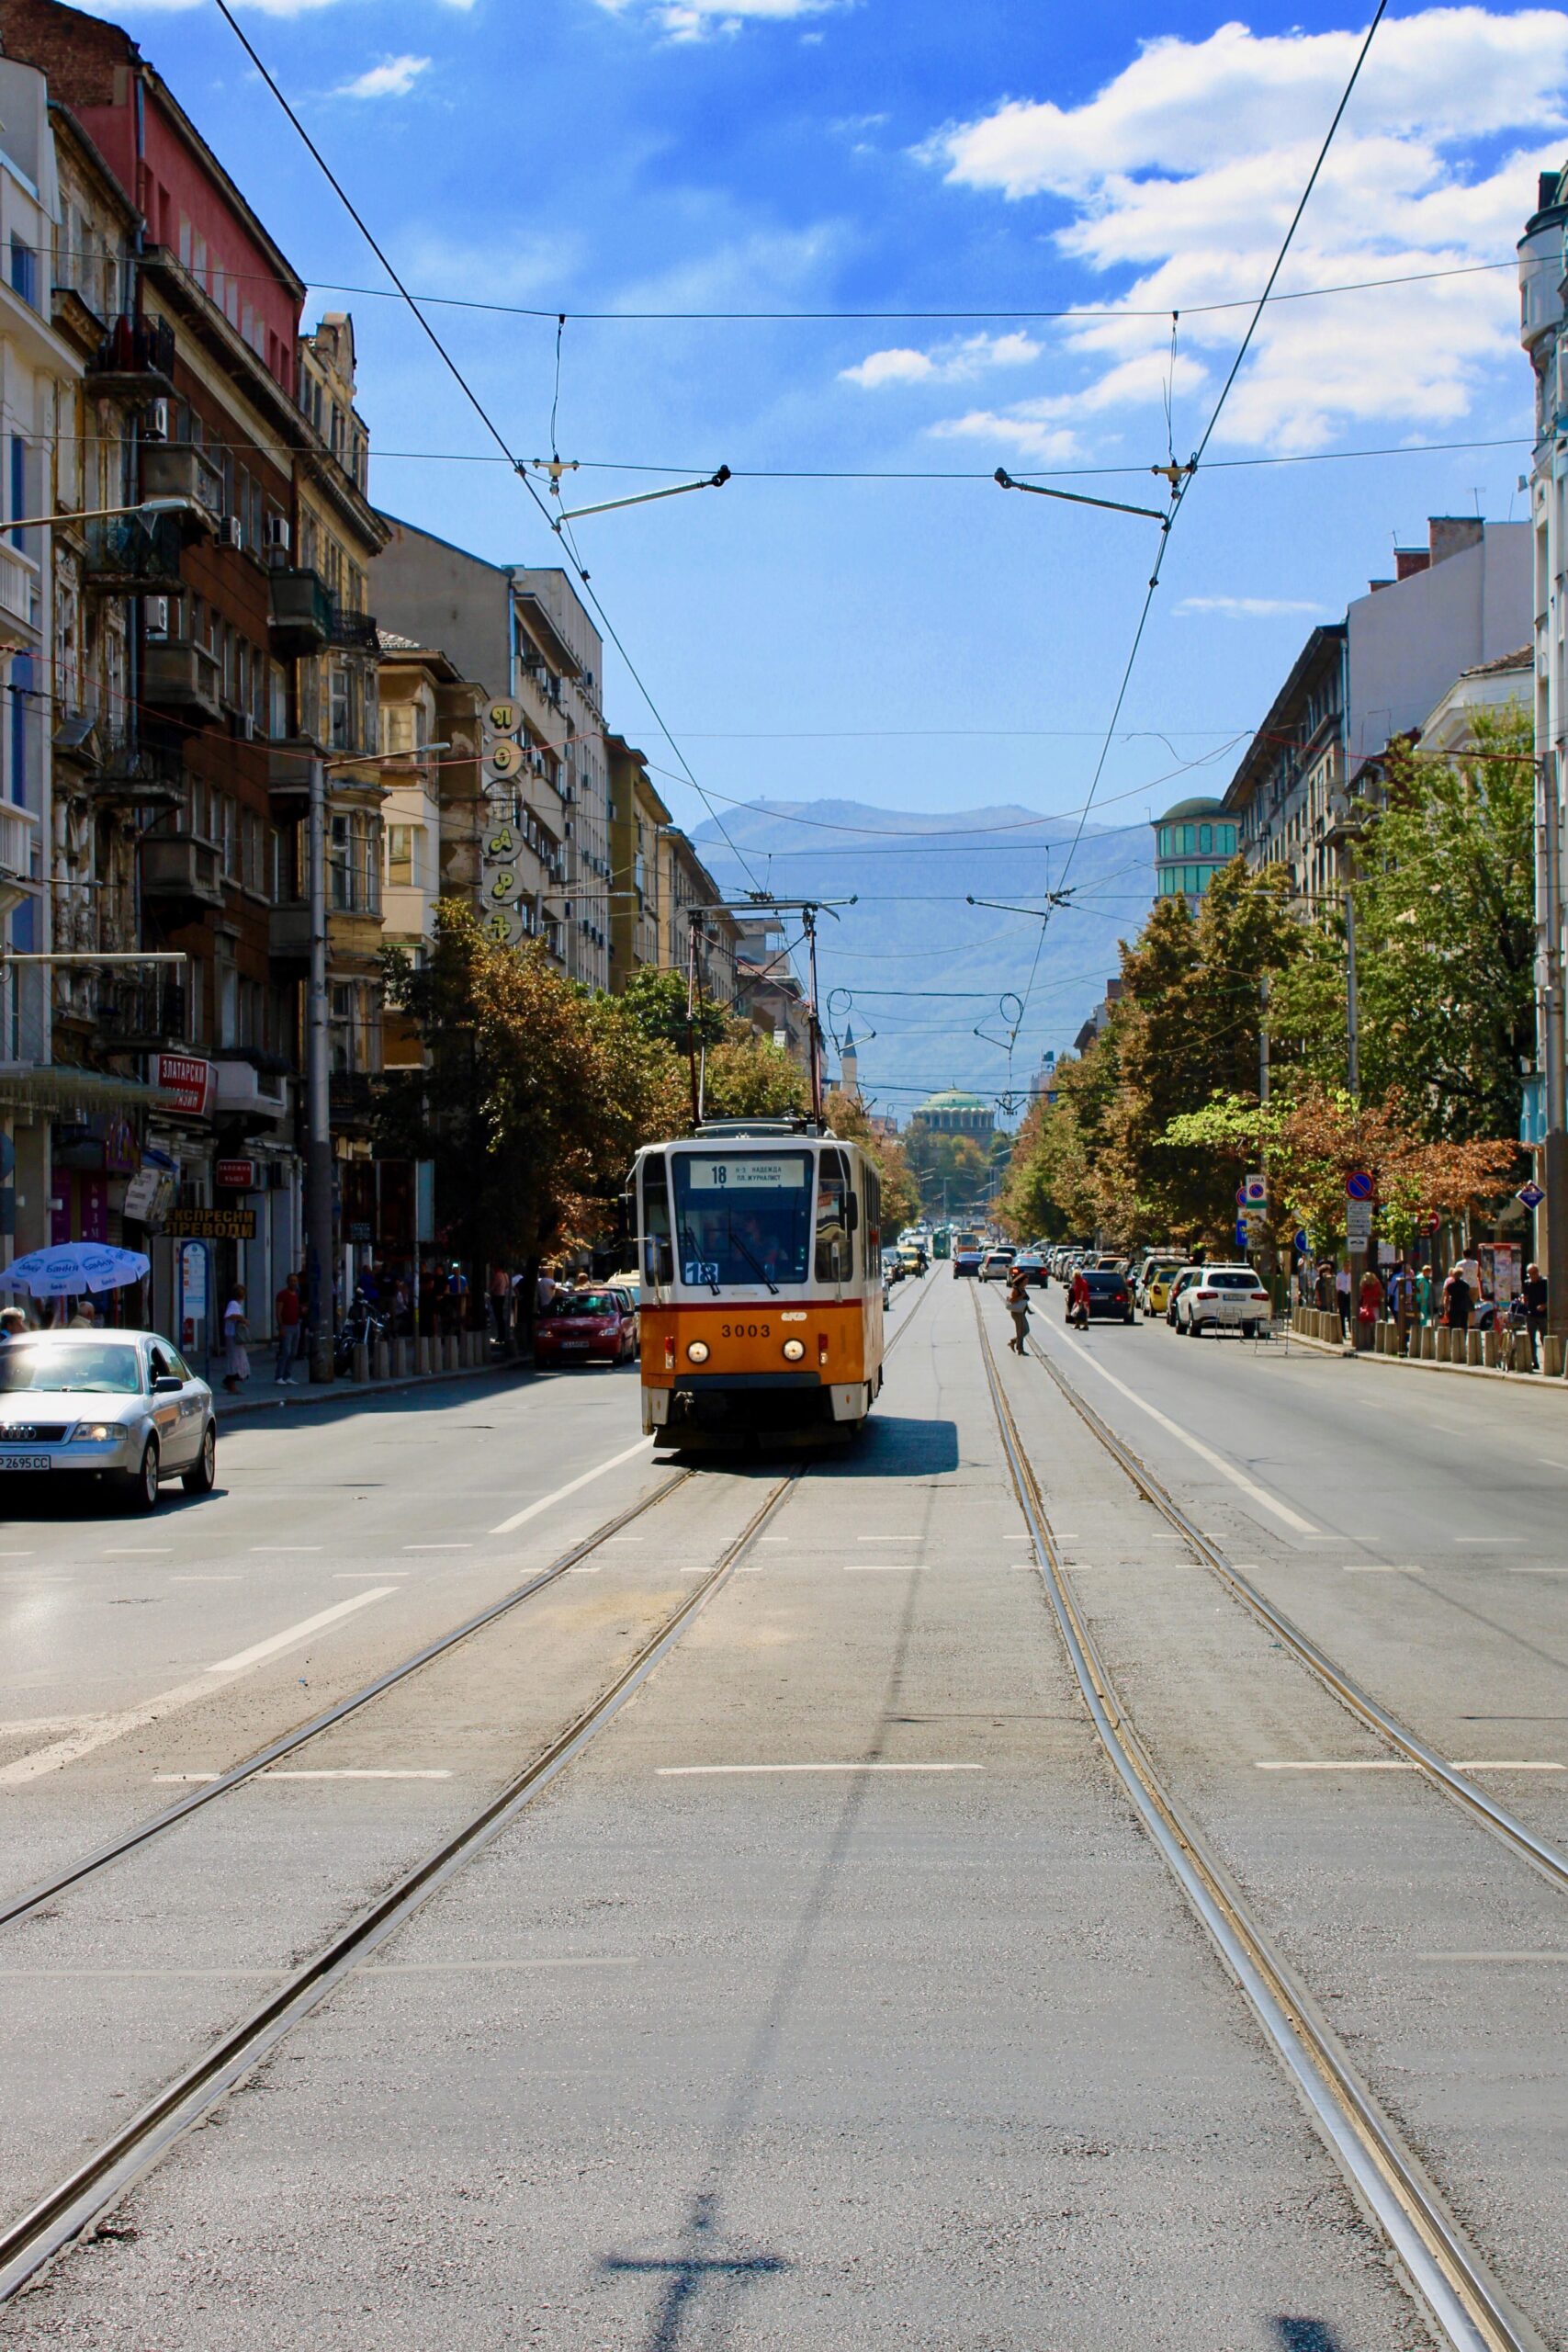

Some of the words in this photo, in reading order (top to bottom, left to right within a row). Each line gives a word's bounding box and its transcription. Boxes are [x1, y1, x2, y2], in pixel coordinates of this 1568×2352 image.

[163, 1059, 205, 1083] ЗЛАТАРСКИ
[711, 1166, 727, 1184] 18
[167, 1209, 254, 1223] ЕКСПРЕСНИ
[165, 1222, 254, 1238] ПРЕВОДИ
[687, 1262, 716, 1284] 18
[721, 1324, 771, 1338] 3003
[6, 1458, 31, 1468] 2695
[34, 1458, 48, 1468] CC
